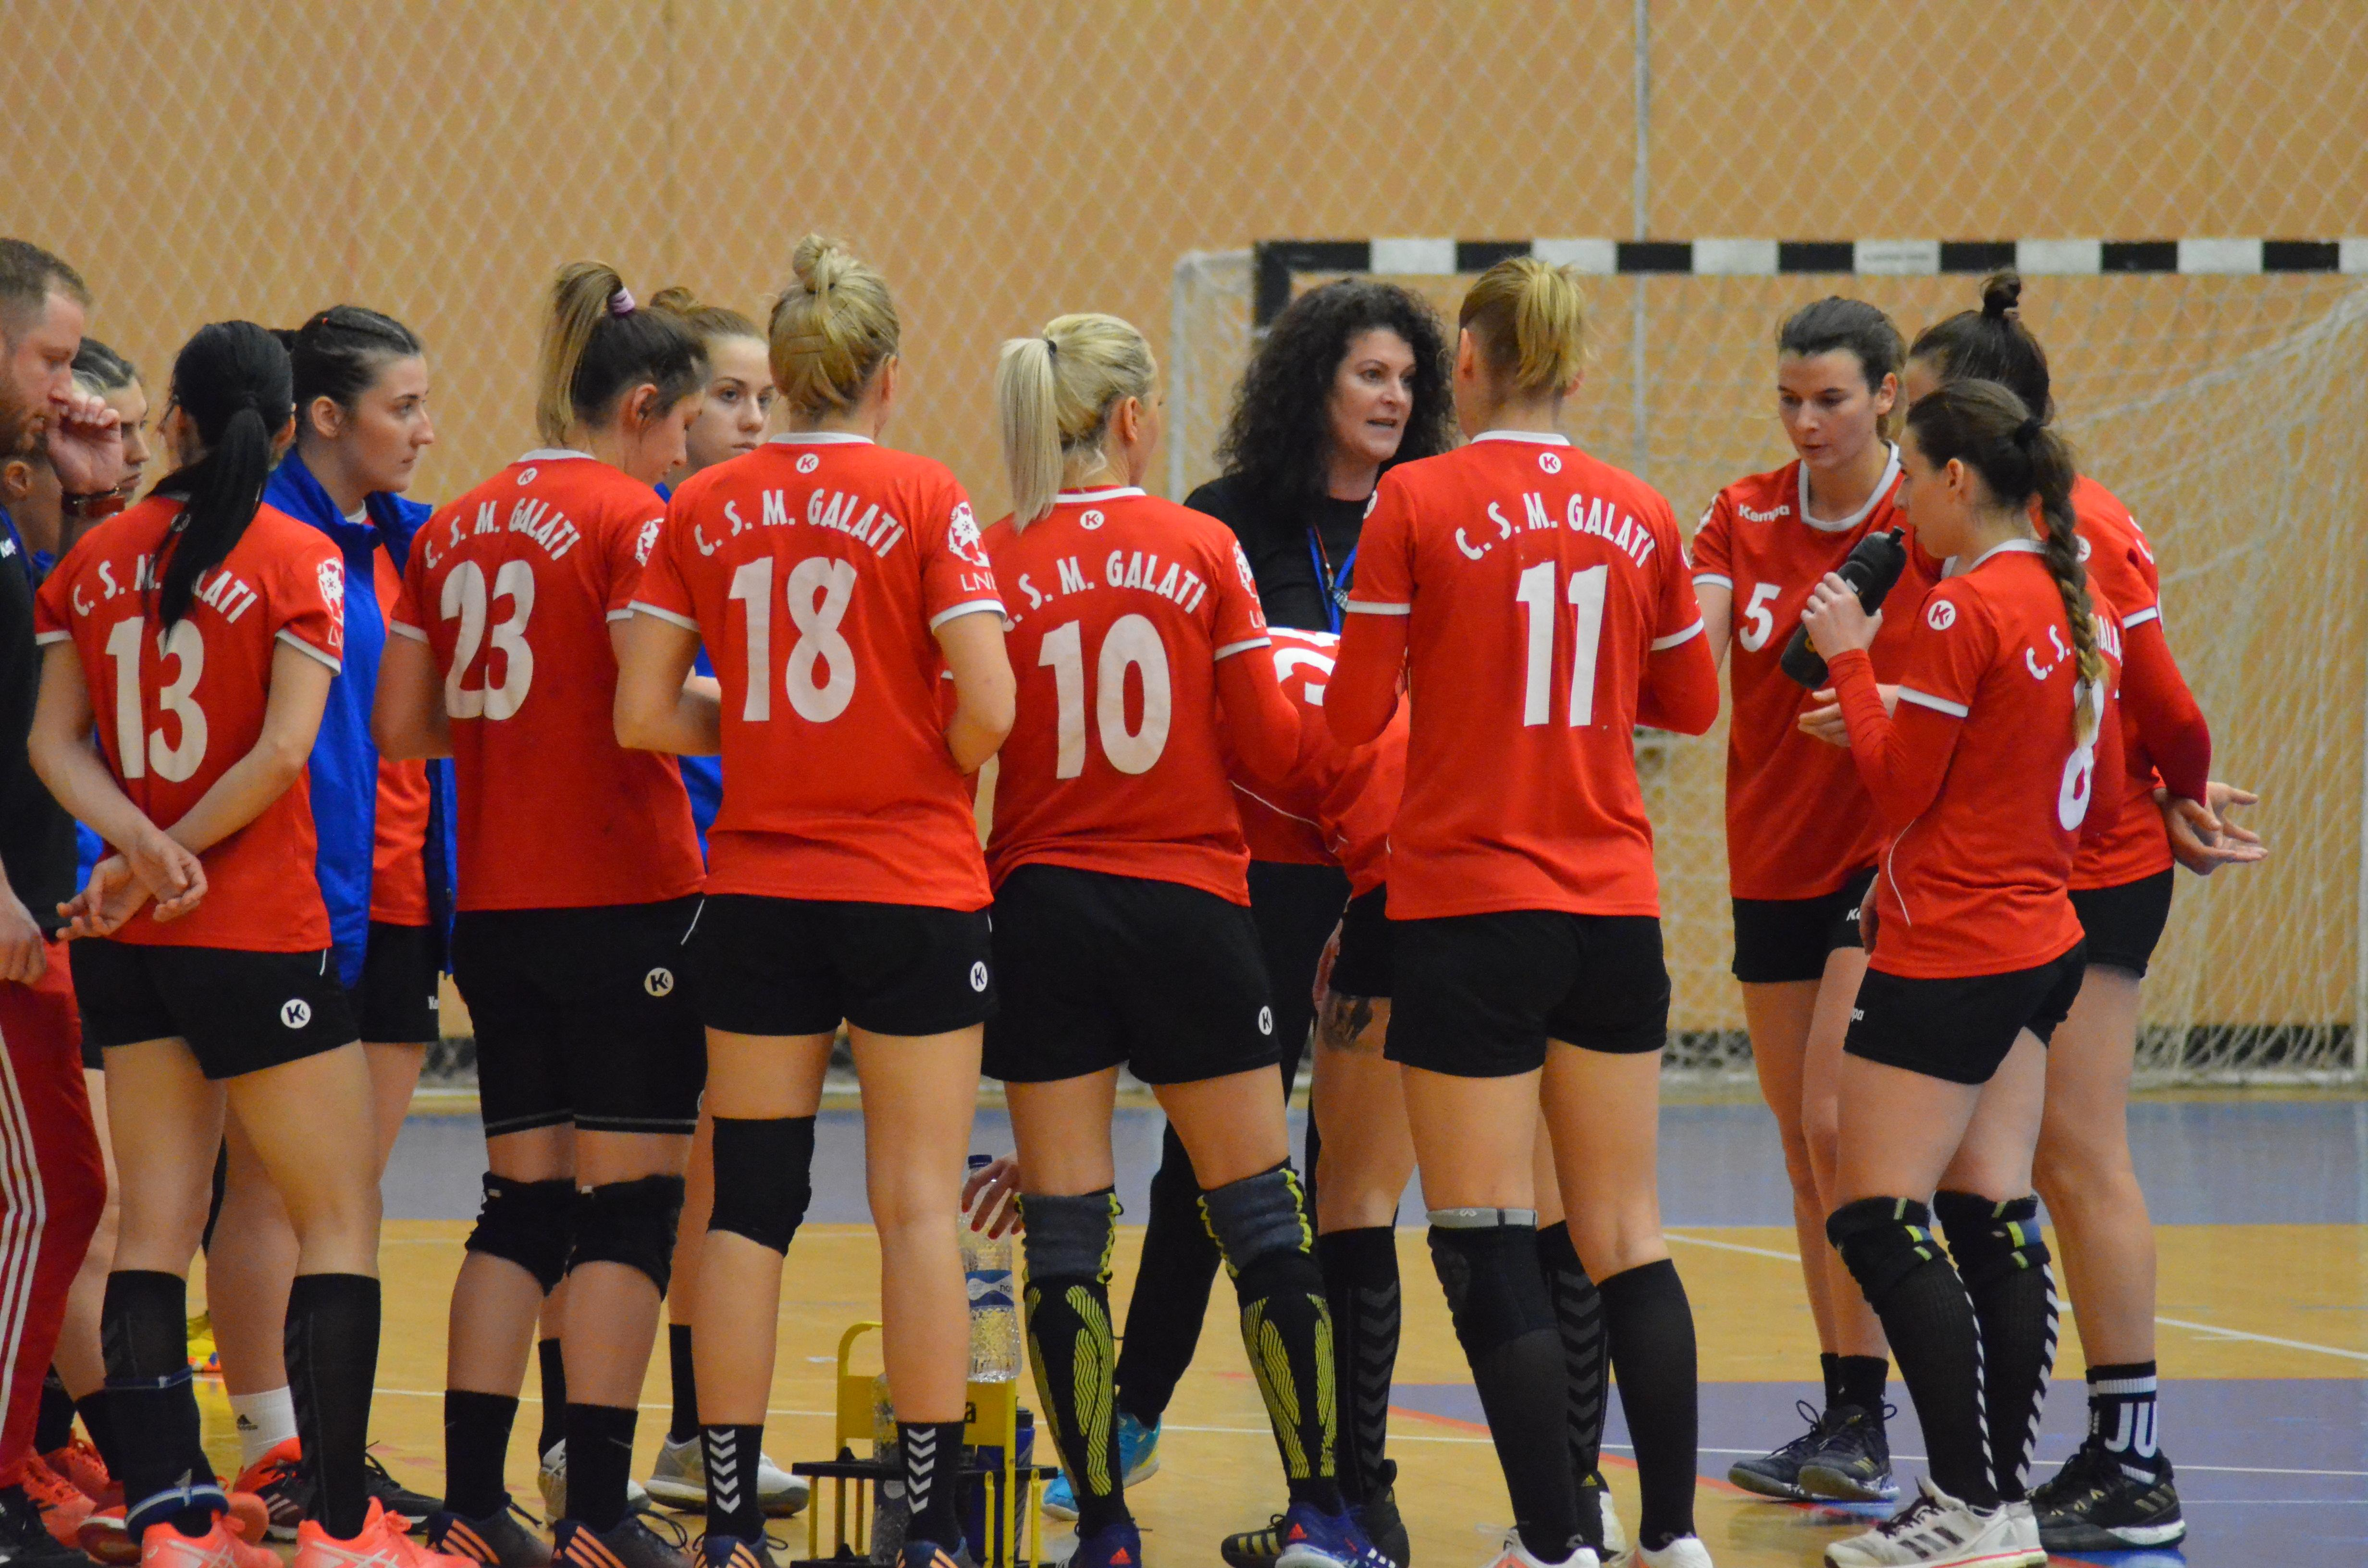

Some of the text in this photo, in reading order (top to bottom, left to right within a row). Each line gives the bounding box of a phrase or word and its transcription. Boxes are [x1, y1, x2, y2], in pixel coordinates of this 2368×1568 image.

[450, 515, 466, 548] S.
[474, 500, 500, 535] M.
[508, 498, 580, 561] GALATI
[694, 488, 905, 558] C. S. M. GALATI
[1455, 491, 1655, 569] C. S. M. GALATI
[1739, 503, 1790, 522] Kempa
[194, 570, 258, 624] LATI
[1056, 556, 1095, 595] M.
[1106, 550, 1207, 613] GALATI
[1739, 581, 1782, 652] 5
[441, 559, 535, 721] 23
[728, 556, 858, 723] 18
[1516, 561, 1609, 728] 11
[105, 616, 208, 783] 13
[1038, 613, 1172, 780] 10
[2104, 1401, 2157, 1458] JU
